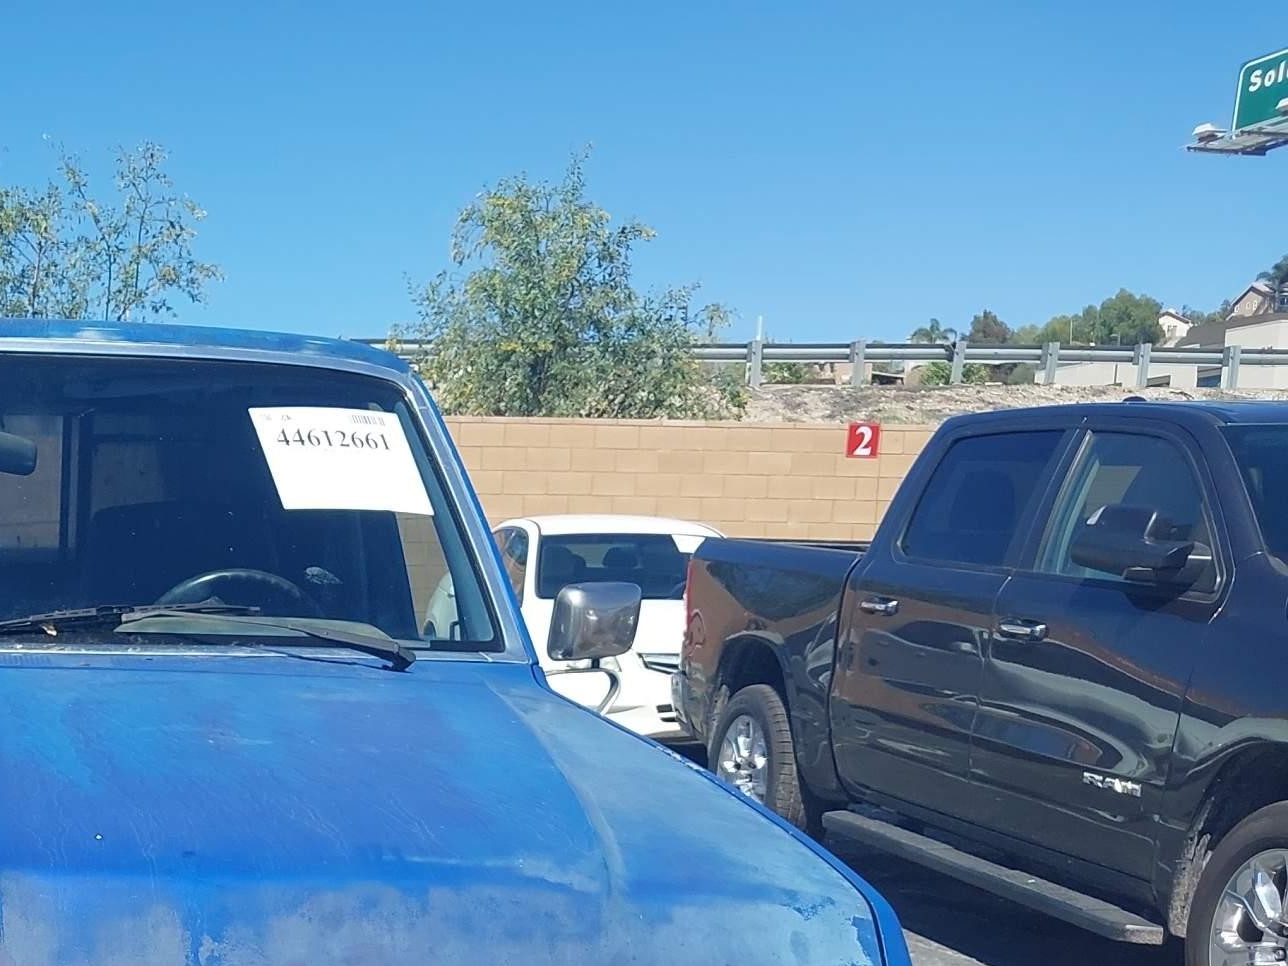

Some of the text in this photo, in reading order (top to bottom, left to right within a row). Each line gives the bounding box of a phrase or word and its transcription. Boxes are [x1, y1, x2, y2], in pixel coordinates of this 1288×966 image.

[1248, 60, 1288, 92] Sol
[277, 428, 391, 451] 44612661
[852, 425, 873, 456] 2
